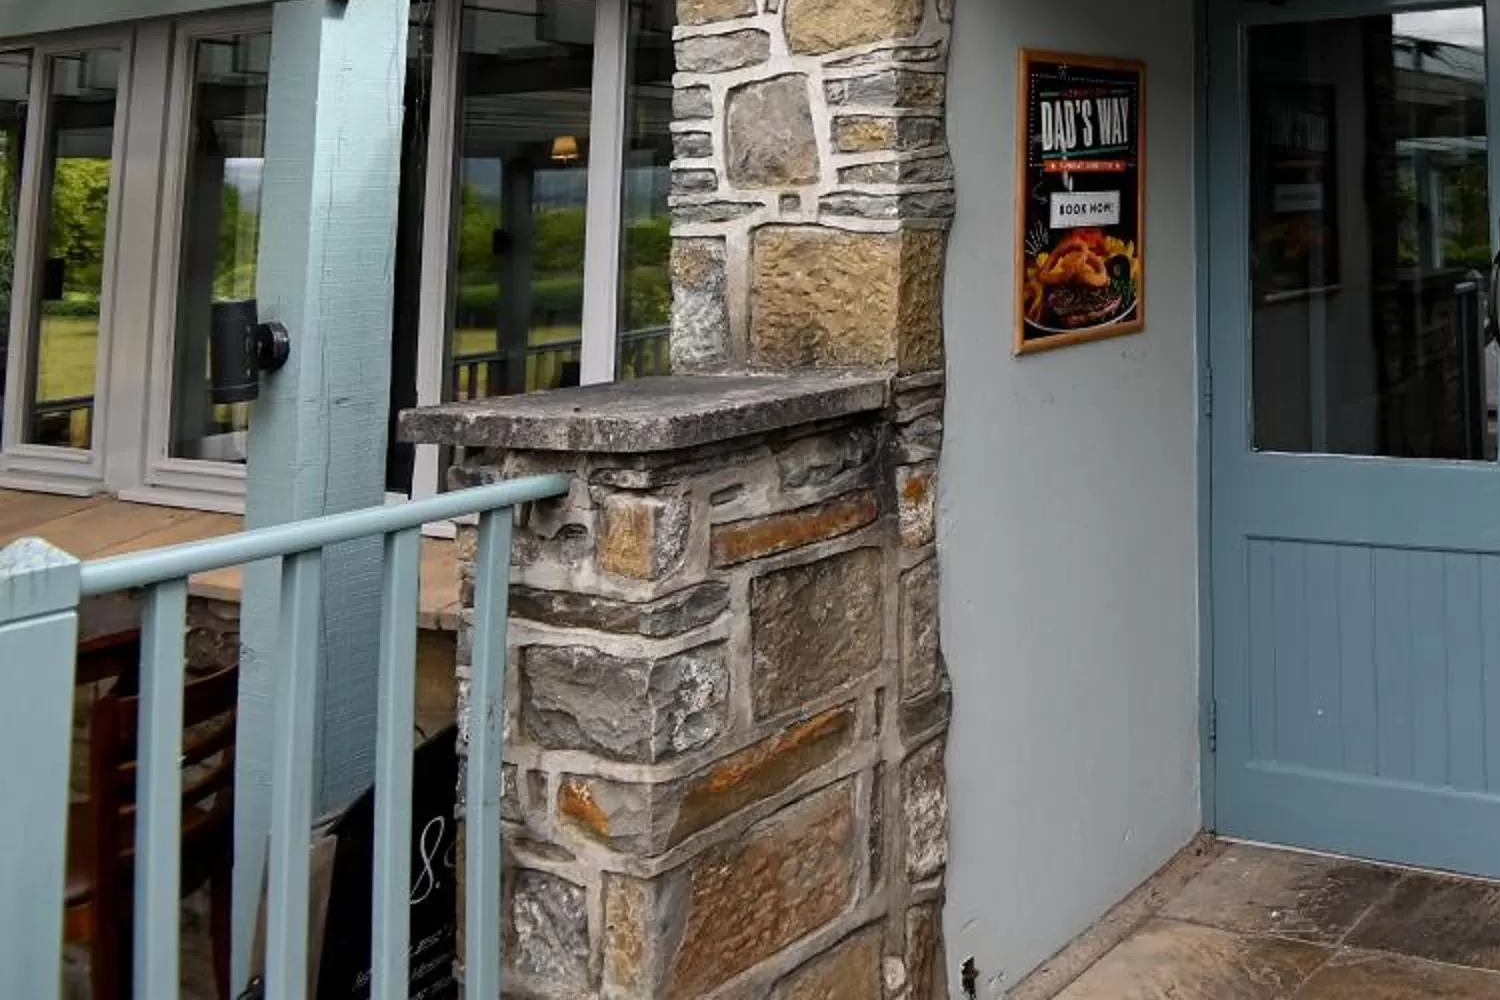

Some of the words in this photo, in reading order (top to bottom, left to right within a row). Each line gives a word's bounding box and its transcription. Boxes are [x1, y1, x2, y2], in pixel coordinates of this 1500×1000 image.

[1041, 99, 1091, 151] DAD'S
[1096, 96, 1129, 145] WAY
[1059, 203, 1087, 215] BOOK
